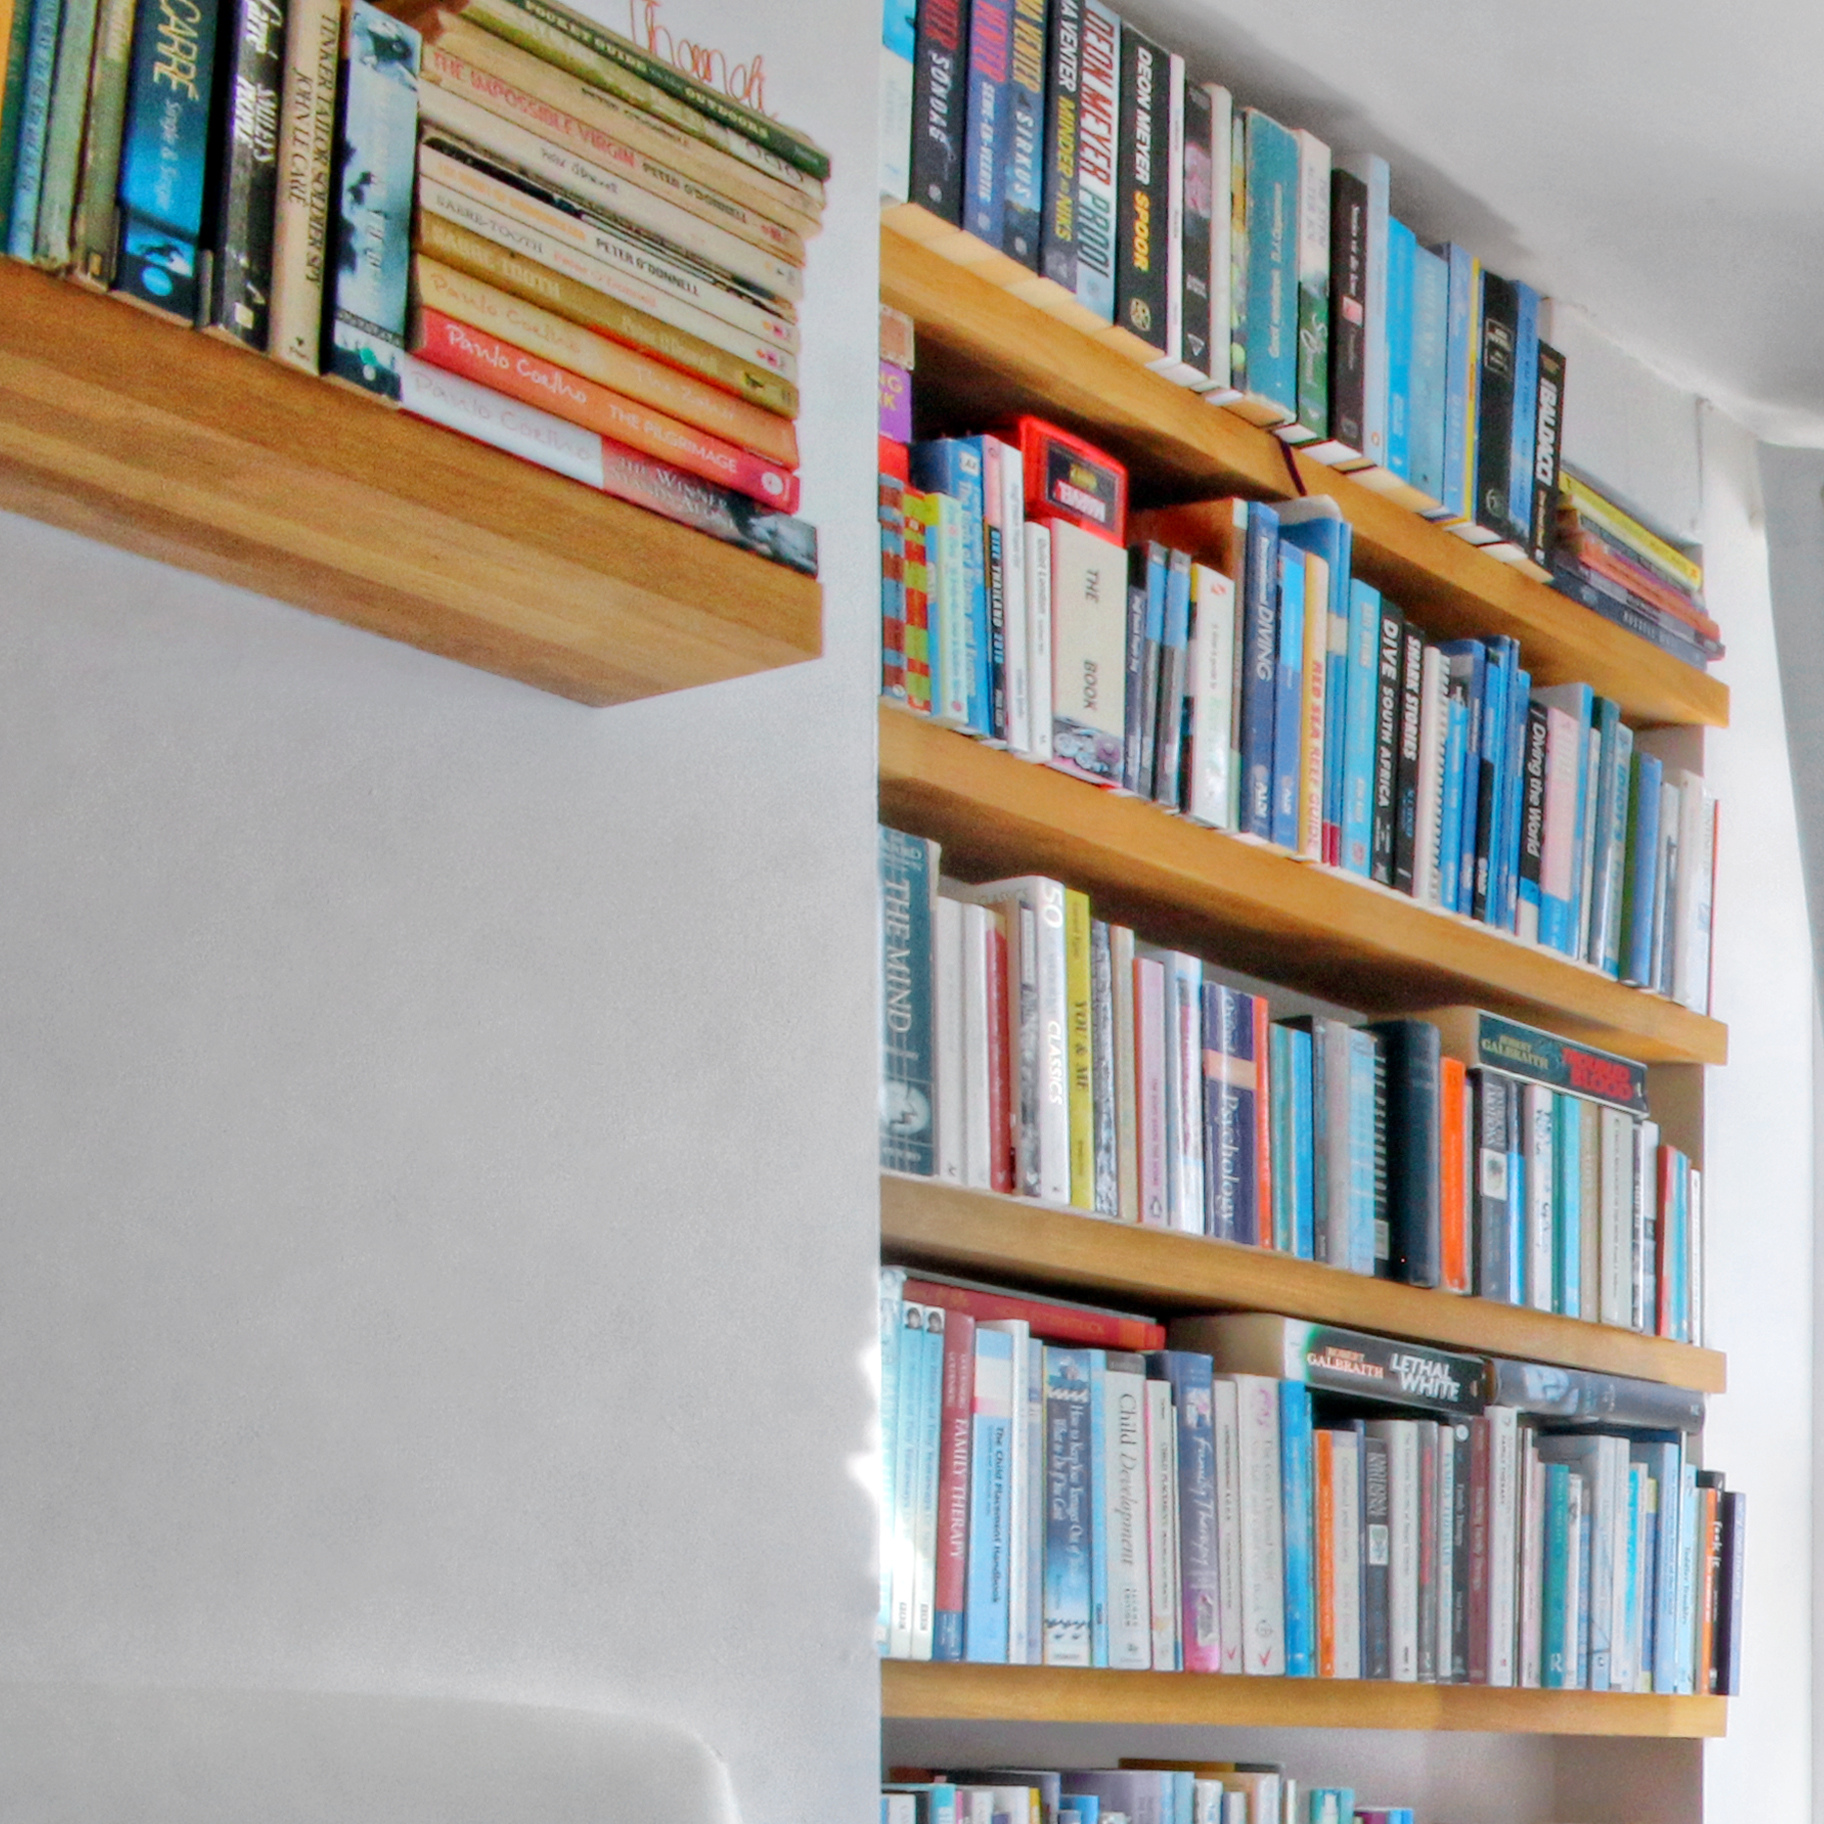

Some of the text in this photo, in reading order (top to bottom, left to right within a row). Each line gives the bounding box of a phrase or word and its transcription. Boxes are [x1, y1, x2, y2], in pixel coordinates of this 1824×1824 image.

[1012, 18, 1042, 93] VENTER
[1058, 21, 1078, 93] VENTER
[288, 67, 314, 208] JOHN LE CARRÉ
[433, 50, 637, 169] THE IMPOSSIBLE VIRGIN
[1057, 95, 1076, 177] MINDER
[1078, 9, 1115, 279] DEON MEYER PROOI
[305, 14, 337, 289] TINKER TAILOR SOLDIER SPY
[642, 161, 681, 191] PETER
[1013, 110, 1035, 200] SIRKUS
[1133, 46, 1153, 272] DEON MEYER SPOOR
[1055, 192, 1072, 242] NIKS
[595, 237, 701, 298] PETER O'DONNELL
[443, 321, 589, 405] Paulo Coelho
[607, 404, 739, 475] THE PILGRIMAGE
[1535, 385, 1557, 486] BALDACCI
[991, 565, 1004, 628] THAILAND
[1083, 569, 1099, 711] THE BOOK
[1255, 604, 1274, 682] DIVING
[1311, 660, 1324, 698] RED
[1310, 709, 1323, 740] SEA
[1377, 619, 1399, 807] DIVE SOUTH AFRICA
[1402, 635, 1419, 761] SHARK STORIES
[1527, 722, 1545, 858] Diving the World
[885, 877, 911, 941] THE
[1042, 885, 1063, 929] 50
[886, 944, 912, 1033] MIND
[1074, 999, 1087, 1037] YOU
[1048, 1019, 1063, 1106] CLASSICS
[1075, 1062, 1089, 1093] ME
[1481, 1037, 1550, 1071] GALBRAITH
[1214, 1091, 1240, 1226] Psychology
[1305, 1352, 1385, 1381] GALBRAITH
[1389, 1352, 1453, 1382] LETHAL
[1398, 1372, 1461, 1403] WHITE
[949, 1417, 969, 1560] FAMILY THERAPY
[991, 1425, 1004, 1604] The Child Placement Handbook
[1115, 1393, 1137, 1566] Child Development
[1190, 1436, 1215, 1567] Family Therapy
